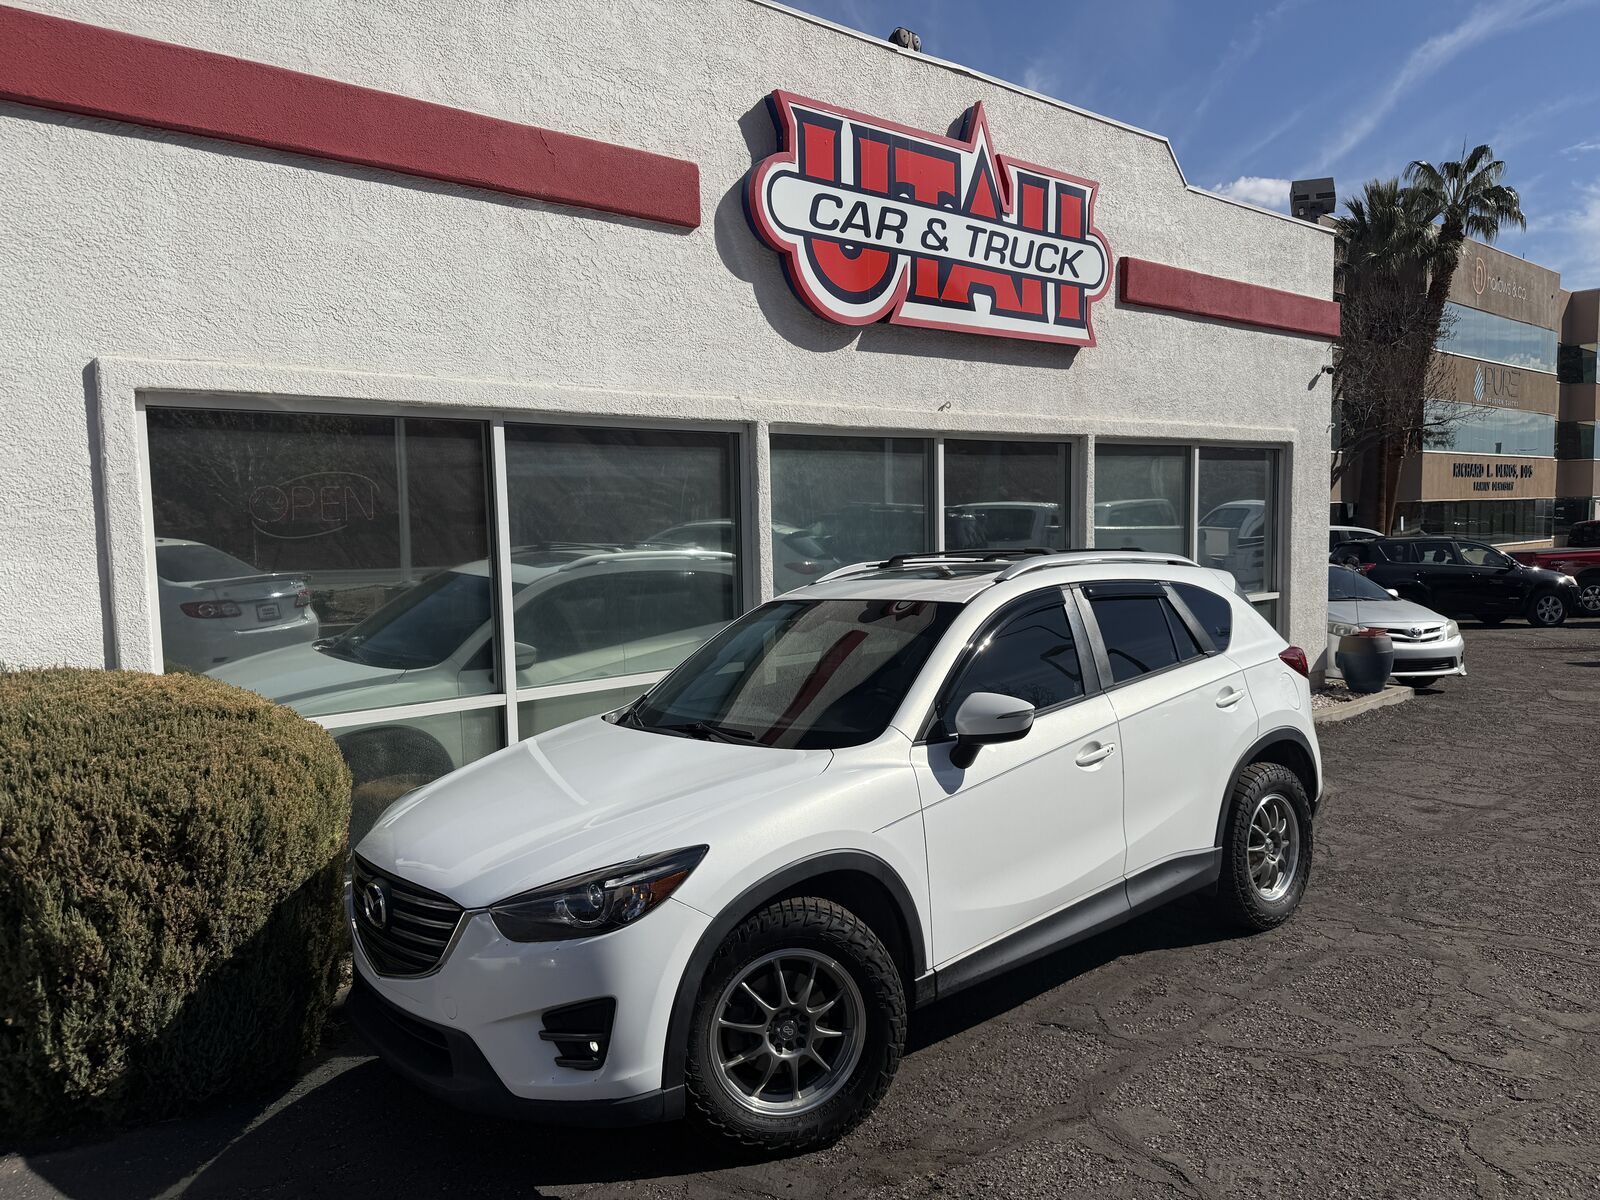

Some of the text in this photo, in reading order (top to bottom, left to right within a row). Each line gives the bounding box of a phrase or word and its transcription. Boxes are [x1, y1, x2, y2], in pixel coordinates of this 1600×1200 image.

[790, 104, 1088, 330] UTAH
[809, 193, 1084, 279] CAR & TRUCK
[1484, 367, 1521, 398] PURE
[1453, 463, 1484, 478] RICHARD
[250, 485, 374, 523] OPEN
